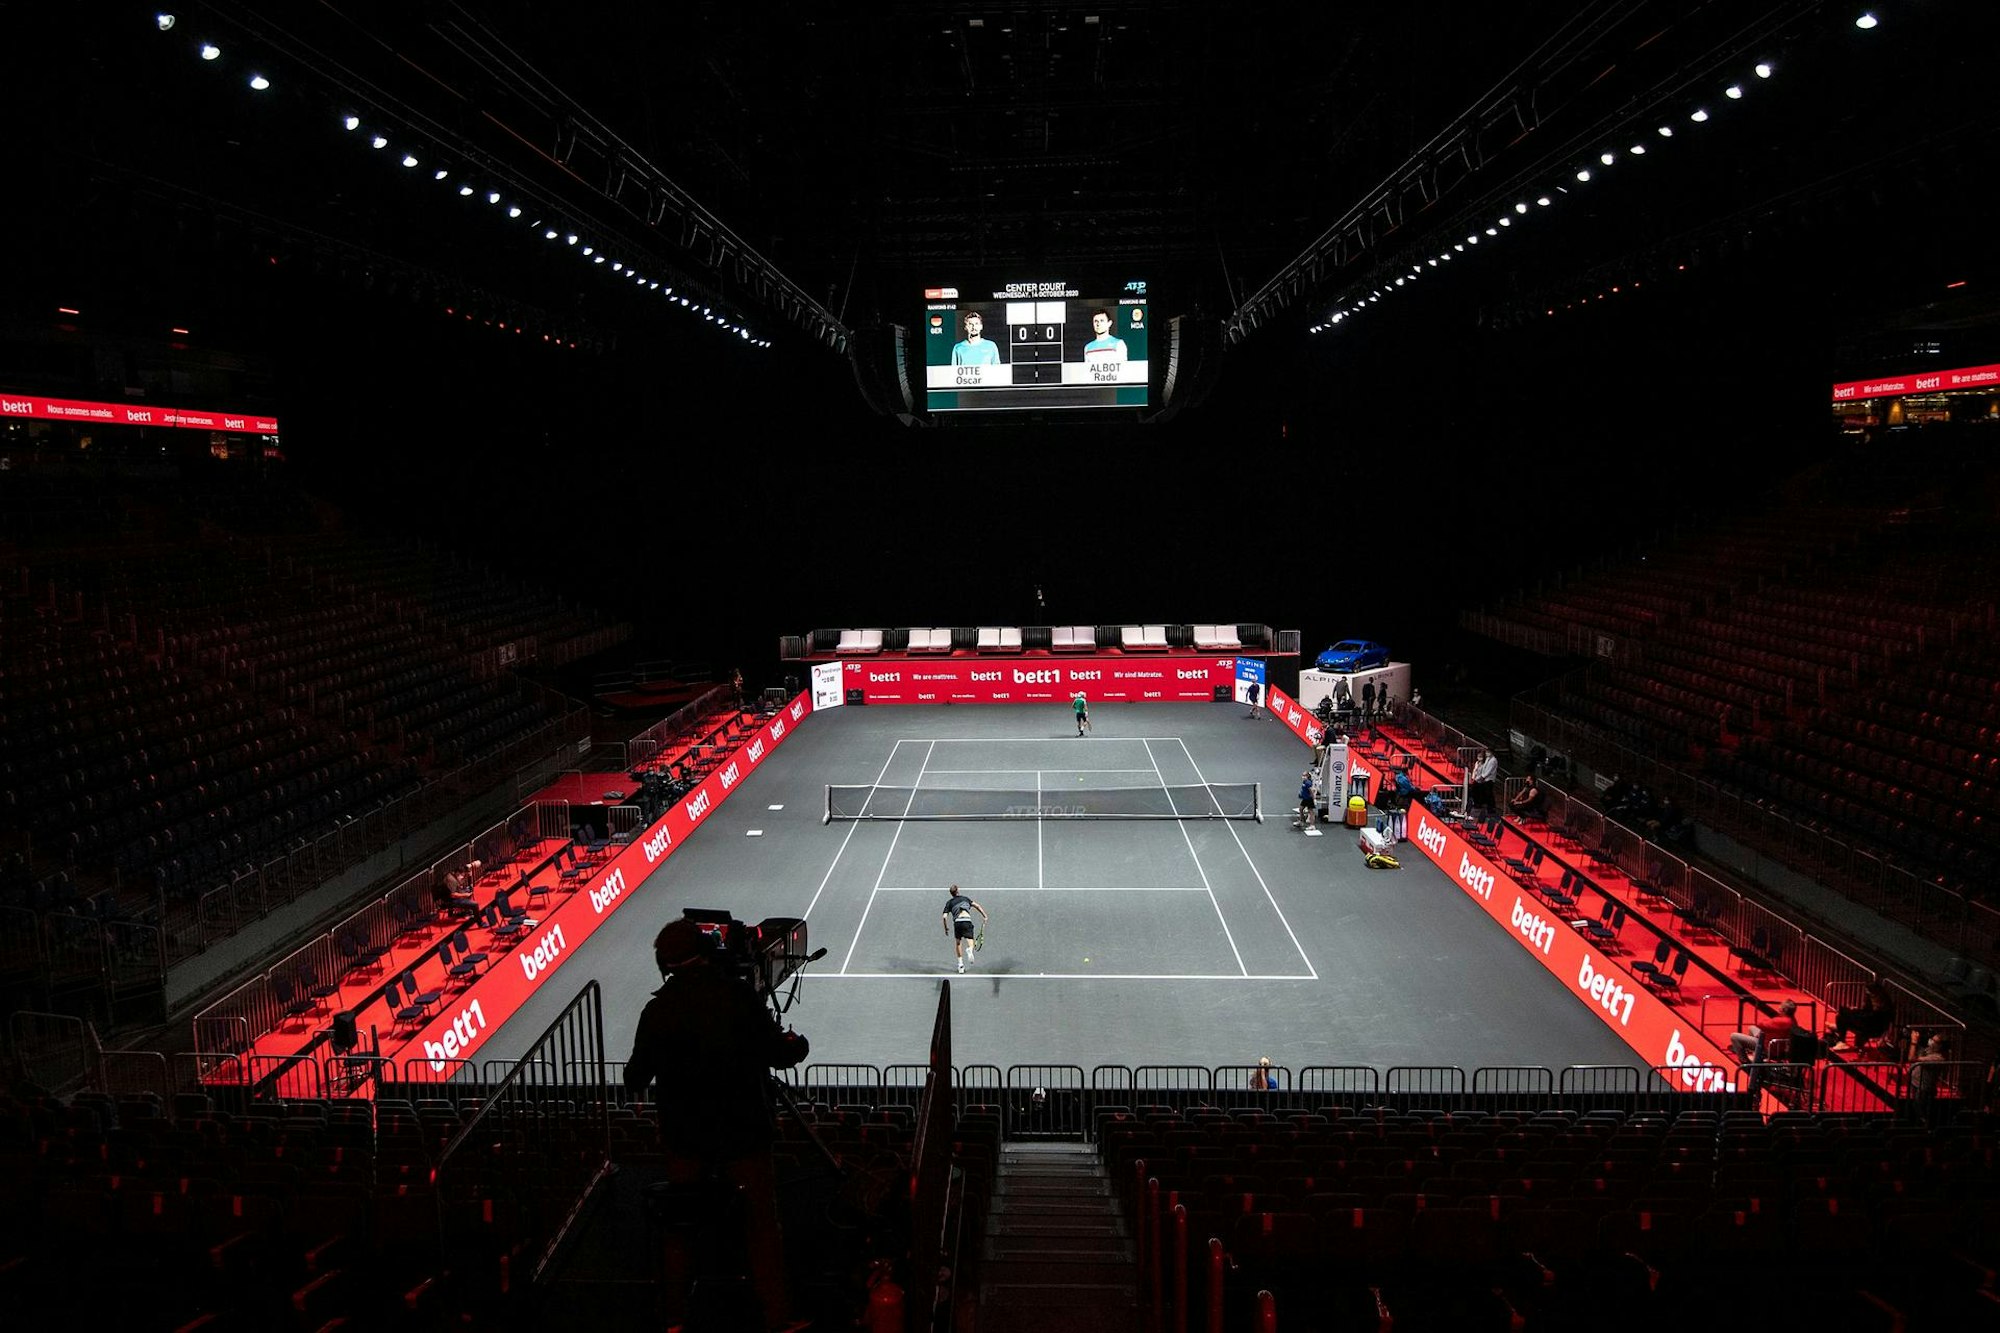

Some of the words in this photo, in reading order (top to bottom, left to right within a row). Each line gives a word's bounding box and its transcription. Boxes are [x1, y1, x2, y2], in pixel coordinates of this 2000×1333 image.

[993, 291, 1031, 299] WEDNESDAY,
[1038, 290, 1065, 298] OCTOBER
[1005, 283, 1037, 292] CENTER
[1039, 282, 1066, 291] COURT
[1019, 327, 1027, 341] 0
[1046, 326, 1054, 340] 0
[957, 366, 980, 376] OTTE
[1090, 363, 1122, 373] ALBOT
[956, 376, 982, 385] Oscar
[1094, 373, 1118, 382] Radu
[1916, 377, 1940, 389] bett1
[1834, 387, 1854, 398] bett1
[2, 400, 33, 414] bett1
[127, 410, 152, 422] bett1
[225, 418, 245, 429] bett1
[1236, 659, 1264, 669] ALPINE
[870, 672, 900, 682] bett1
[971, 671, 1002, 681] bett1
[1013, 669, 1060, 684] bett1
[1070, 670, 1101, 680] bett1
[1177, 669, 1208, 679] bett1
[1271, 692, 1286, 714] bett1
[790, 701, 804, 722] bett1
[1287, 704, 1303, 729] bett1
[769, 718, 786, 741] bett1
[746, 738, 765, 763] bett1
[719, 761, 740, 790] bett1
[1333, 775, 1342, 807] Allianz
[685, 788, 711, 822] bett1
[642, 823, 672, 863] bett1
[1417, 815, 1447, 858] bett1
[1458, 851, 1495, 901] bett1
[588, 867, 626, 914] bett1
[1510, 896, 1555, 955] bett1
[519, 922, 567, 982] bett1
[1578, 953, 1636, 1026] bett1
[423, 998, 488, 1073] bett1
